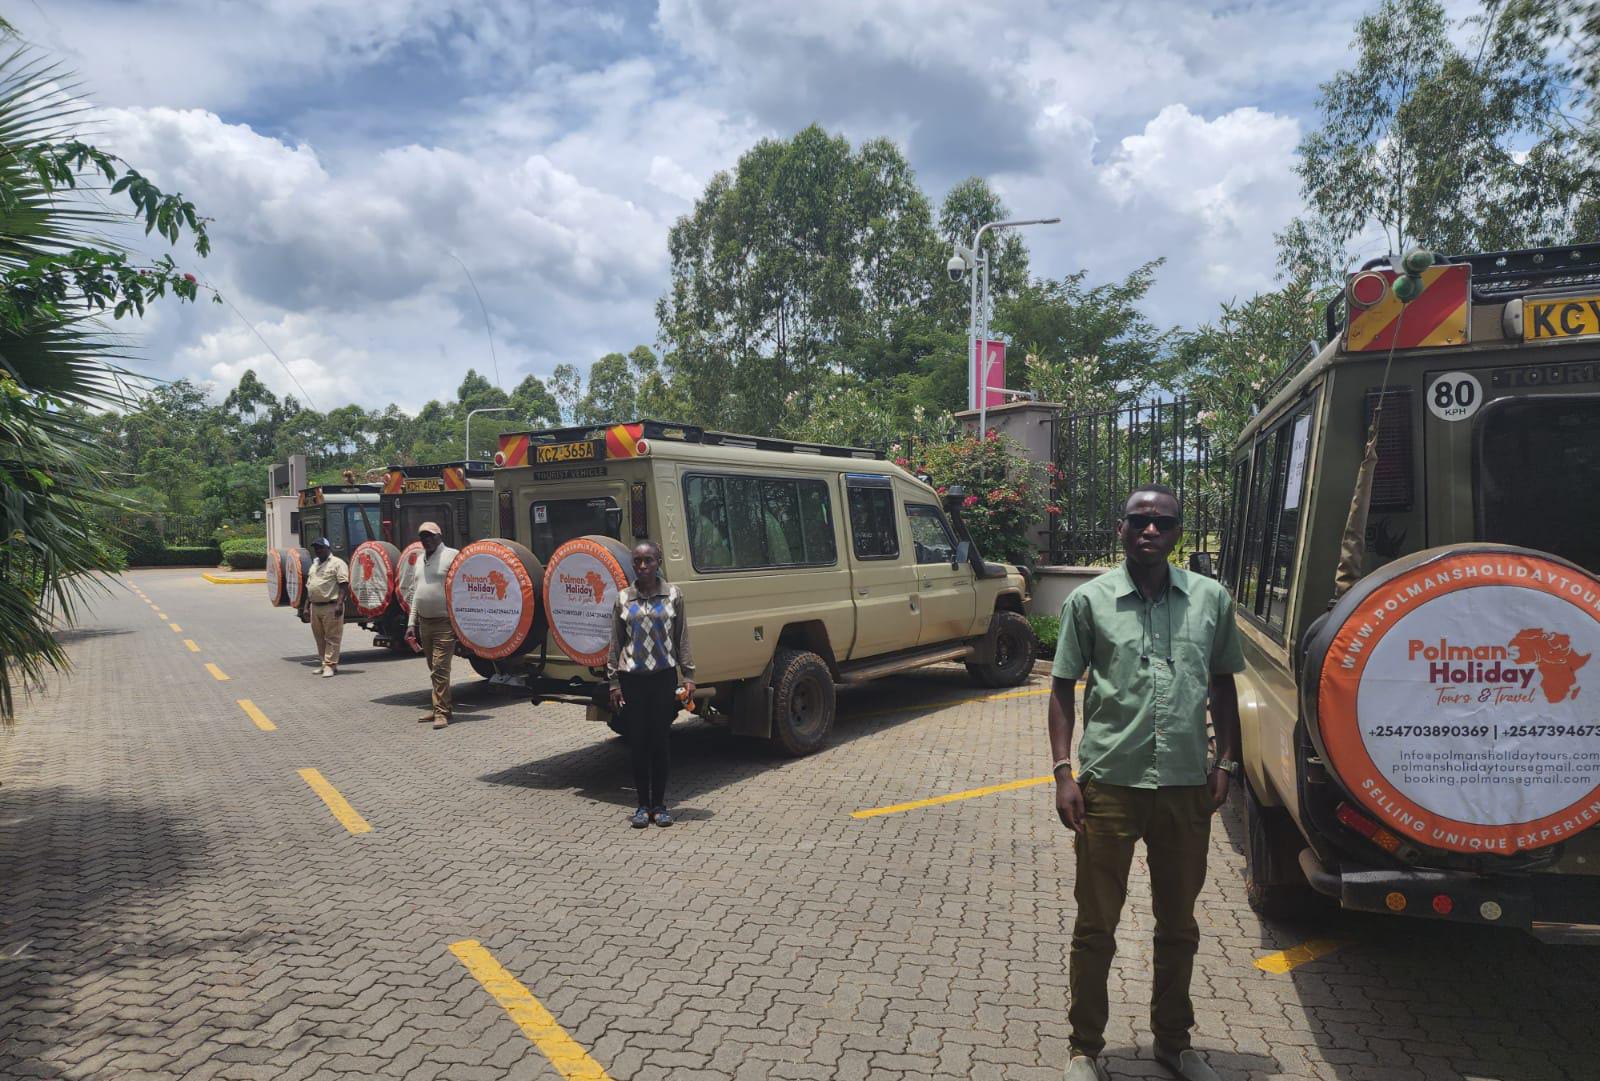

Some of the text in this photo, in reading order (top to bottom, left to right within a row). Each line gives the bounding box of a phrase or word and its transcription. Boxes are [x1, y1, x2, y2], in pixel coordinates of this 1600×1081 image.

[1434, 380, 1475, 408] 80
[1445, 408, 1466, 416] KPH
[537, 443, 593, 463] KCZ 365A
[467, 583, 496, 594] Holiday
[565, 584, 593, 597] Holiday
[1429, 661, 1535, 688] Holiday
[1435, 686, 1535, 706] Tours & Travel
[1368, 725, 1489, 737] +254703890369
[1361, 778, 1426, 832] SELLING
[1432, 828, 1507, 850] UNIQUE
